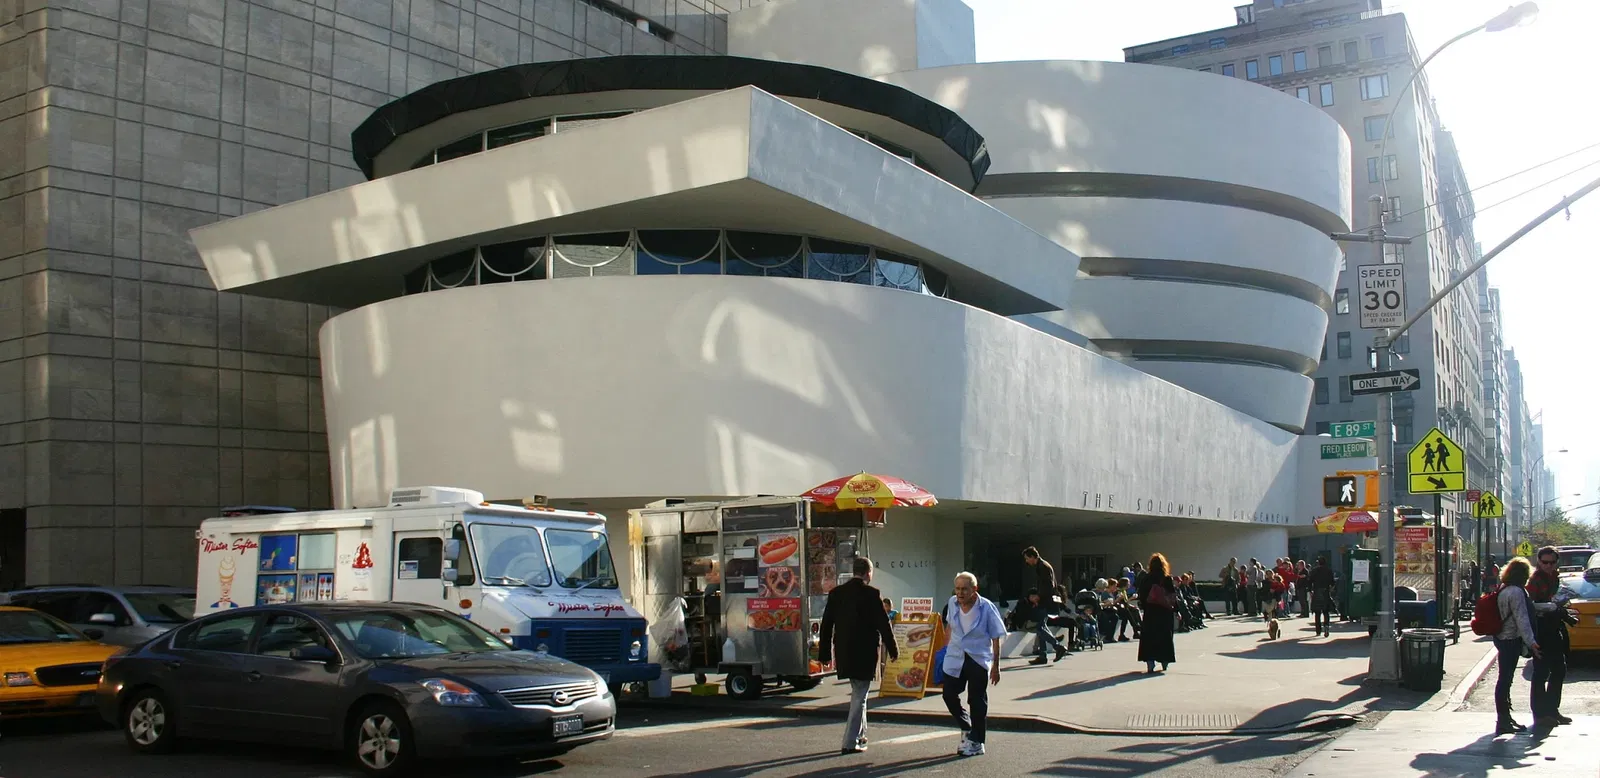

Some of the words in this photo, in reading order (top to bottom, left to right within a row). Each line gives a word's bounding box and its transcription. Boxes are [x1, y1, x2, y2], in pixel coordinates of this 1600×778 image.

[1361, 269, 1401, 278] SPEED
[1365, 280, 1396, 289] LIMIT
[1364, 290, 1400, 310] 30
[1359, 379, 1378, 389] ONE
[1391, 376, 1410, 386] WAY
[1335, 425, 1342, 437] E
[1346, 424, 1360, 436] 89
[1322, 445, 1340, 454] FRED
[1343, 443, 1366, 452] LEBOW
[1083, 491, 1114, 508] THE
[1137, 498, 1202, 516] SOLOMON
[1234, 510, 1289, 524] GUGGENHEIM
[201, 538, 228, 553] Mister
[232, 538, 258, 555] Softee
[548, 602, 590, 614] Mister
[593, 603, 625, 617] Softee
